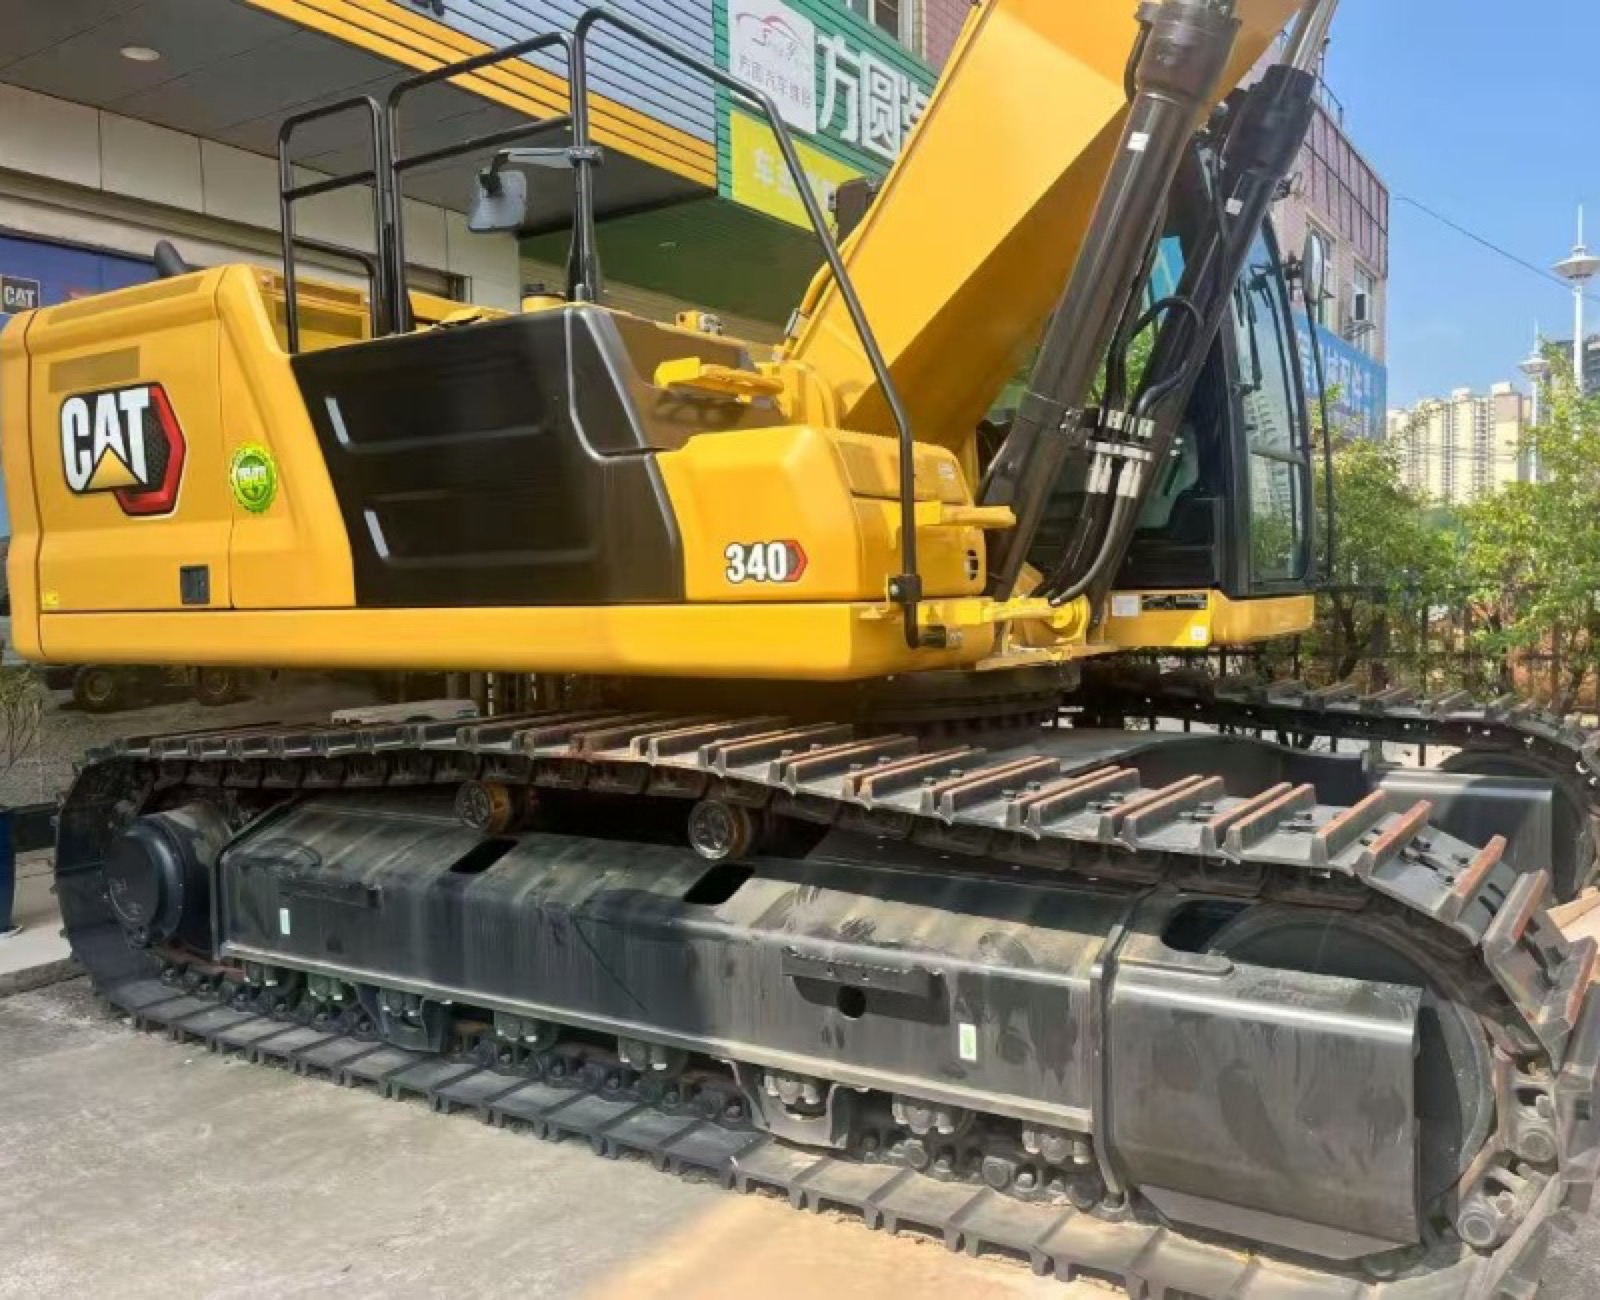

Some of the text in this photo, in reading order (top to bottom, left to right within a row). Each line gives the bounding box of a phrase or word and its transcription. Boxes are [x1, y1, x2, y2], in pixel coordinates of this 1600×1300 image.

[4, 285, 35, 309] CAT
[63, 386, 150, 492] CAT
[725, 542, 788, 582] 340
